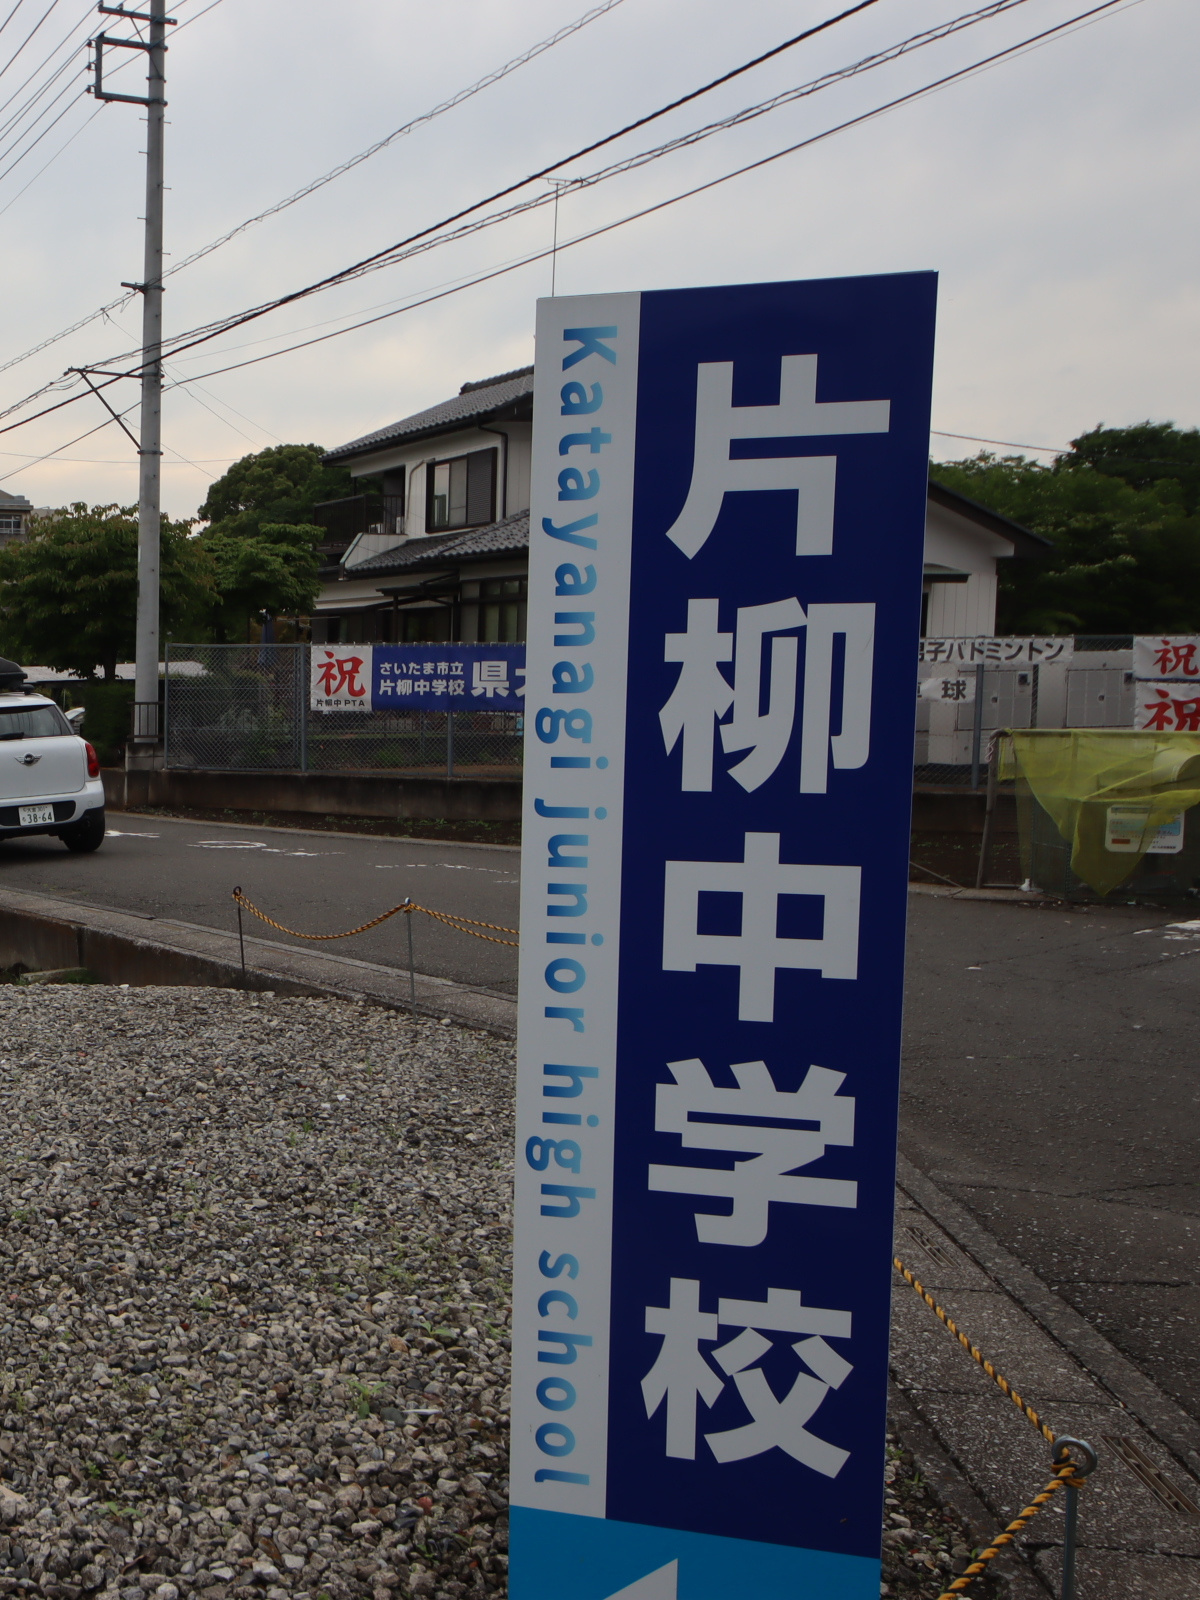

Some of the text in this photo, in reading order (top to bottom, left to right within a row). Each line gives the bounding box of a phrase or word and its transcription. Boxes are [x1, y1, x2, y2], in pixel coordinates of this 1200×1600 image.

[380, 661, 464, 675] さいたま市立
[919, 640, 1065, 662] 子バドミントン
[1152, 639, 1200, 676] 祝
[316, 650, 367, 697] 祝
[379, 679, 465, 696] 片柳中学校
[525, 325, 617, 1486] Katayanagi junior high school
[640, 353, 891, 1479] 片柳中学校
